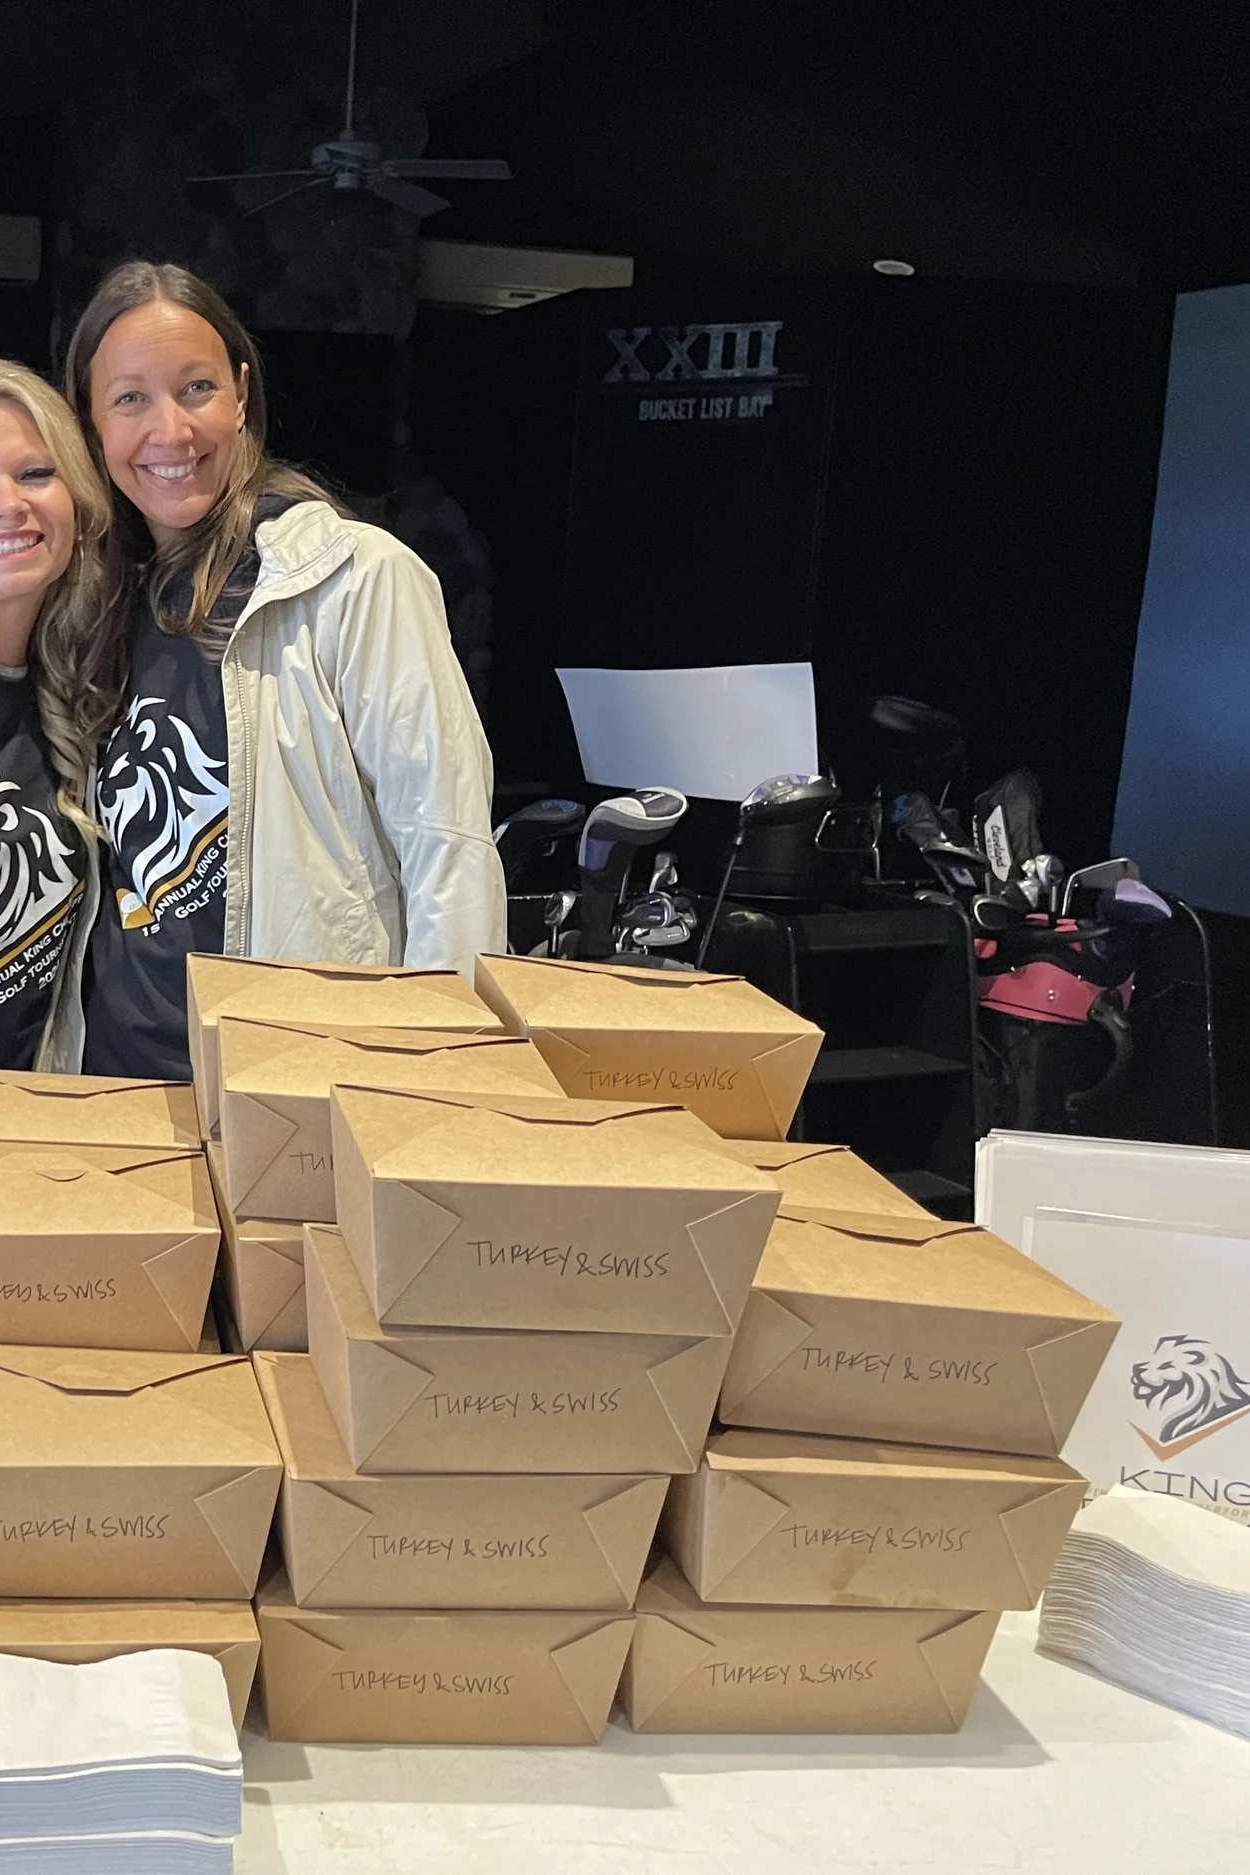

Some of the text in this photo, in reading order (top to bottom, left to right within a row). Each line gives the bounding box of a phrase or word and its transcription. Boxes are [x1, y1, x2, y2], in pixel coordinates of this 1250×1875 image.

[603, 321, 783, 383] XXIII
[638, 398, 697, 421] BUCKET
[701, 397, 735, 420] LIST
[990, 825, 1008, 868] Cleveland
[154, 878, 203, 922] ANNUAL
[195, 847, 220, 878] KING
[174, 890, 211, 919] GOLF
[22, 935, 52, 963] KING
[583, 1067, 739, 1091] TURKEY & SWISS
[467, 1240, 670, 1278] TURKEY & SWISS
[36, 1283, 50, 1303] &
[53, 1278, 117, 1303] SWISS
[801, 1347, 999, 1386] TURKEY & SWISS
[424, 1387, 623, 1418] TURKEY & SWISS
[1120, 1466, 1250, 1507] KING
[85, 1517, 98, 1537] &
[100, 1514, 170, 1540] SWISS
[780, 1524, 972, 1554] TURKEY & SWISS
[366, 1534, 550, 1560] TURKEY & SWISS
[331, 1670, 517, 1695] TURKEY & SWISS
[702, 1660, 879, 1687] TURKEY & SWISS
